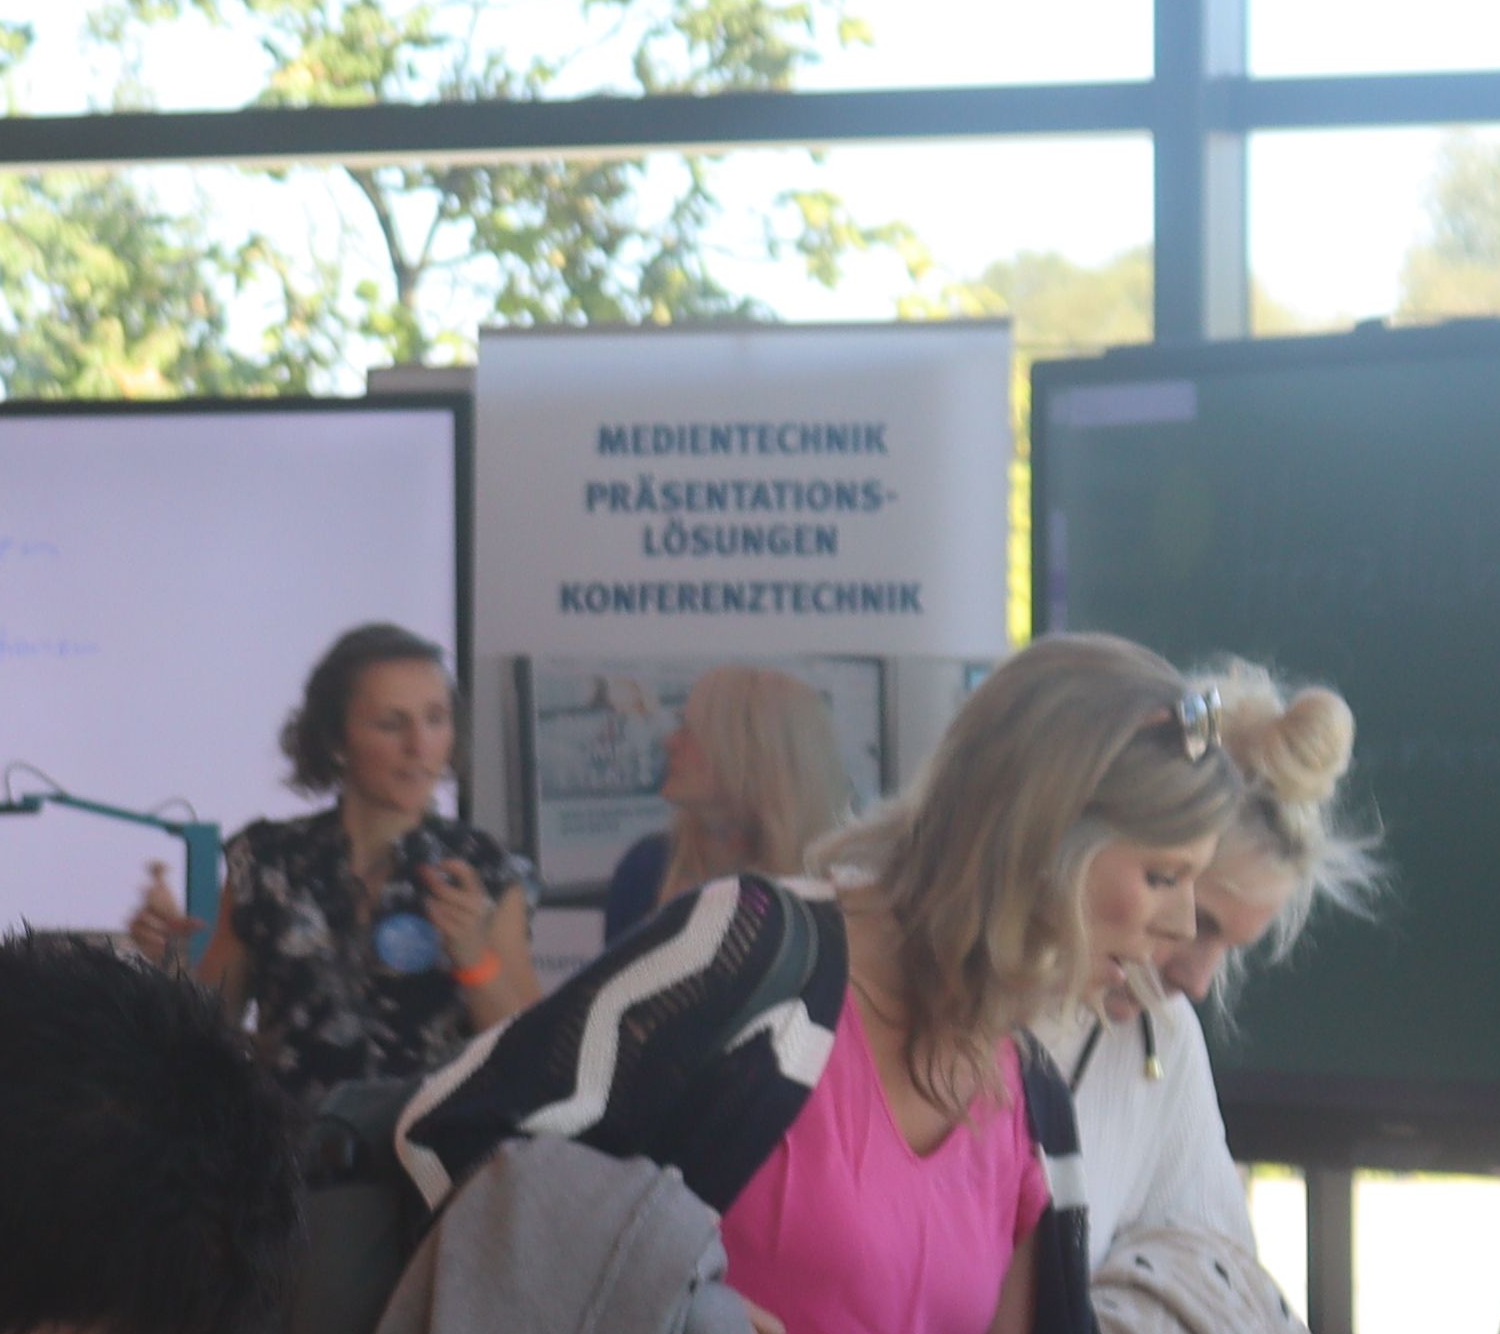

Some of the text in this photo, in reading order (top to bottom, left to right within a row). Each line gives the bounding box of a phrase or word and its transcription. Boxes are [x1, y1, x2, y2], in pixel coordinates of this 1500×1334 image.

[596, 423, 888, 457] MEDIENTECHNIK
[584, 475, 900, 513] PRÄSENTATIONS-
[643, 519, 838, 556] LÖSUNGEN
[559, 581, 922, 615] KONFERENZTECHNIK
